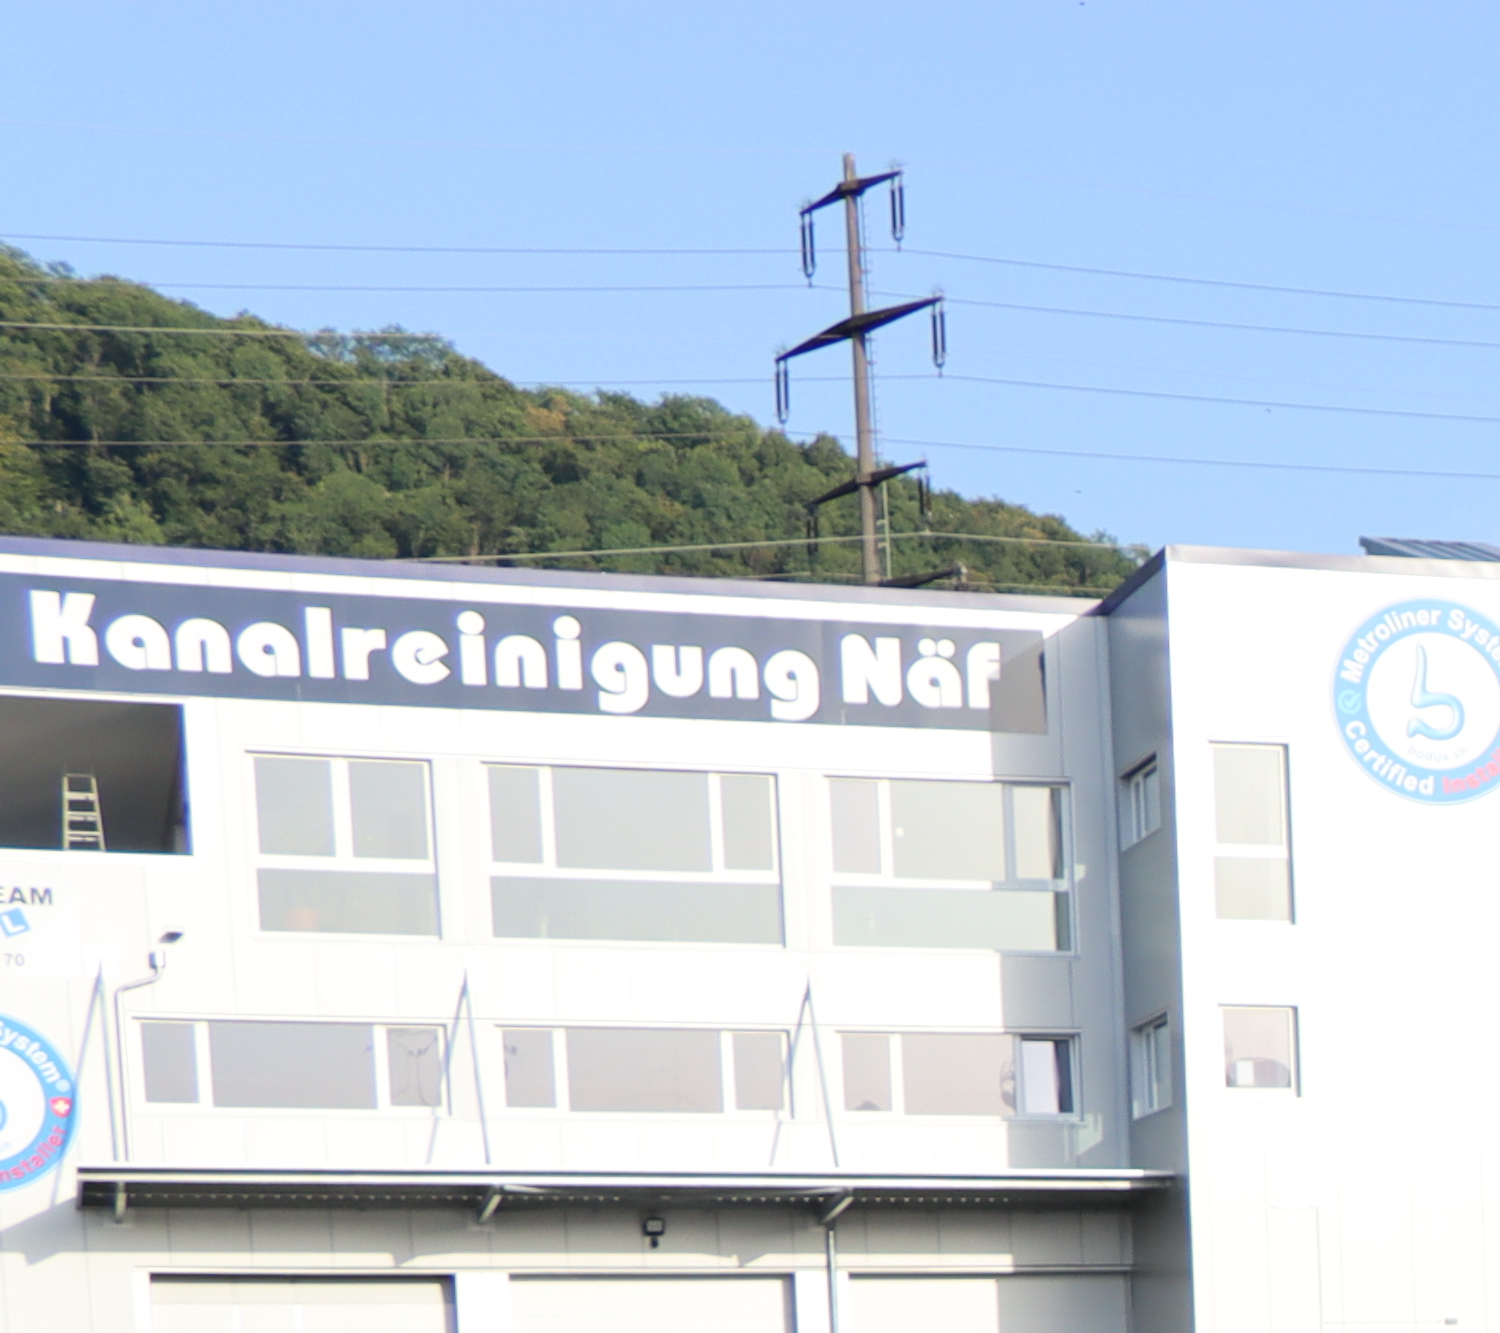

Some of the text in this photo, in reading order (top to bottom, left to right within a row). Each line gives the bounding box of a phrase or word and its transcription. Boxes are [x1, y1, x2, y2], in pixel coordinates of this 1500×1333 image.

[29, 590, 1000, 721] Kanalreinigung Näf
[1340, 608, 1442, 683] Metroliner
[1345, 720, 1435, 795] Certified
